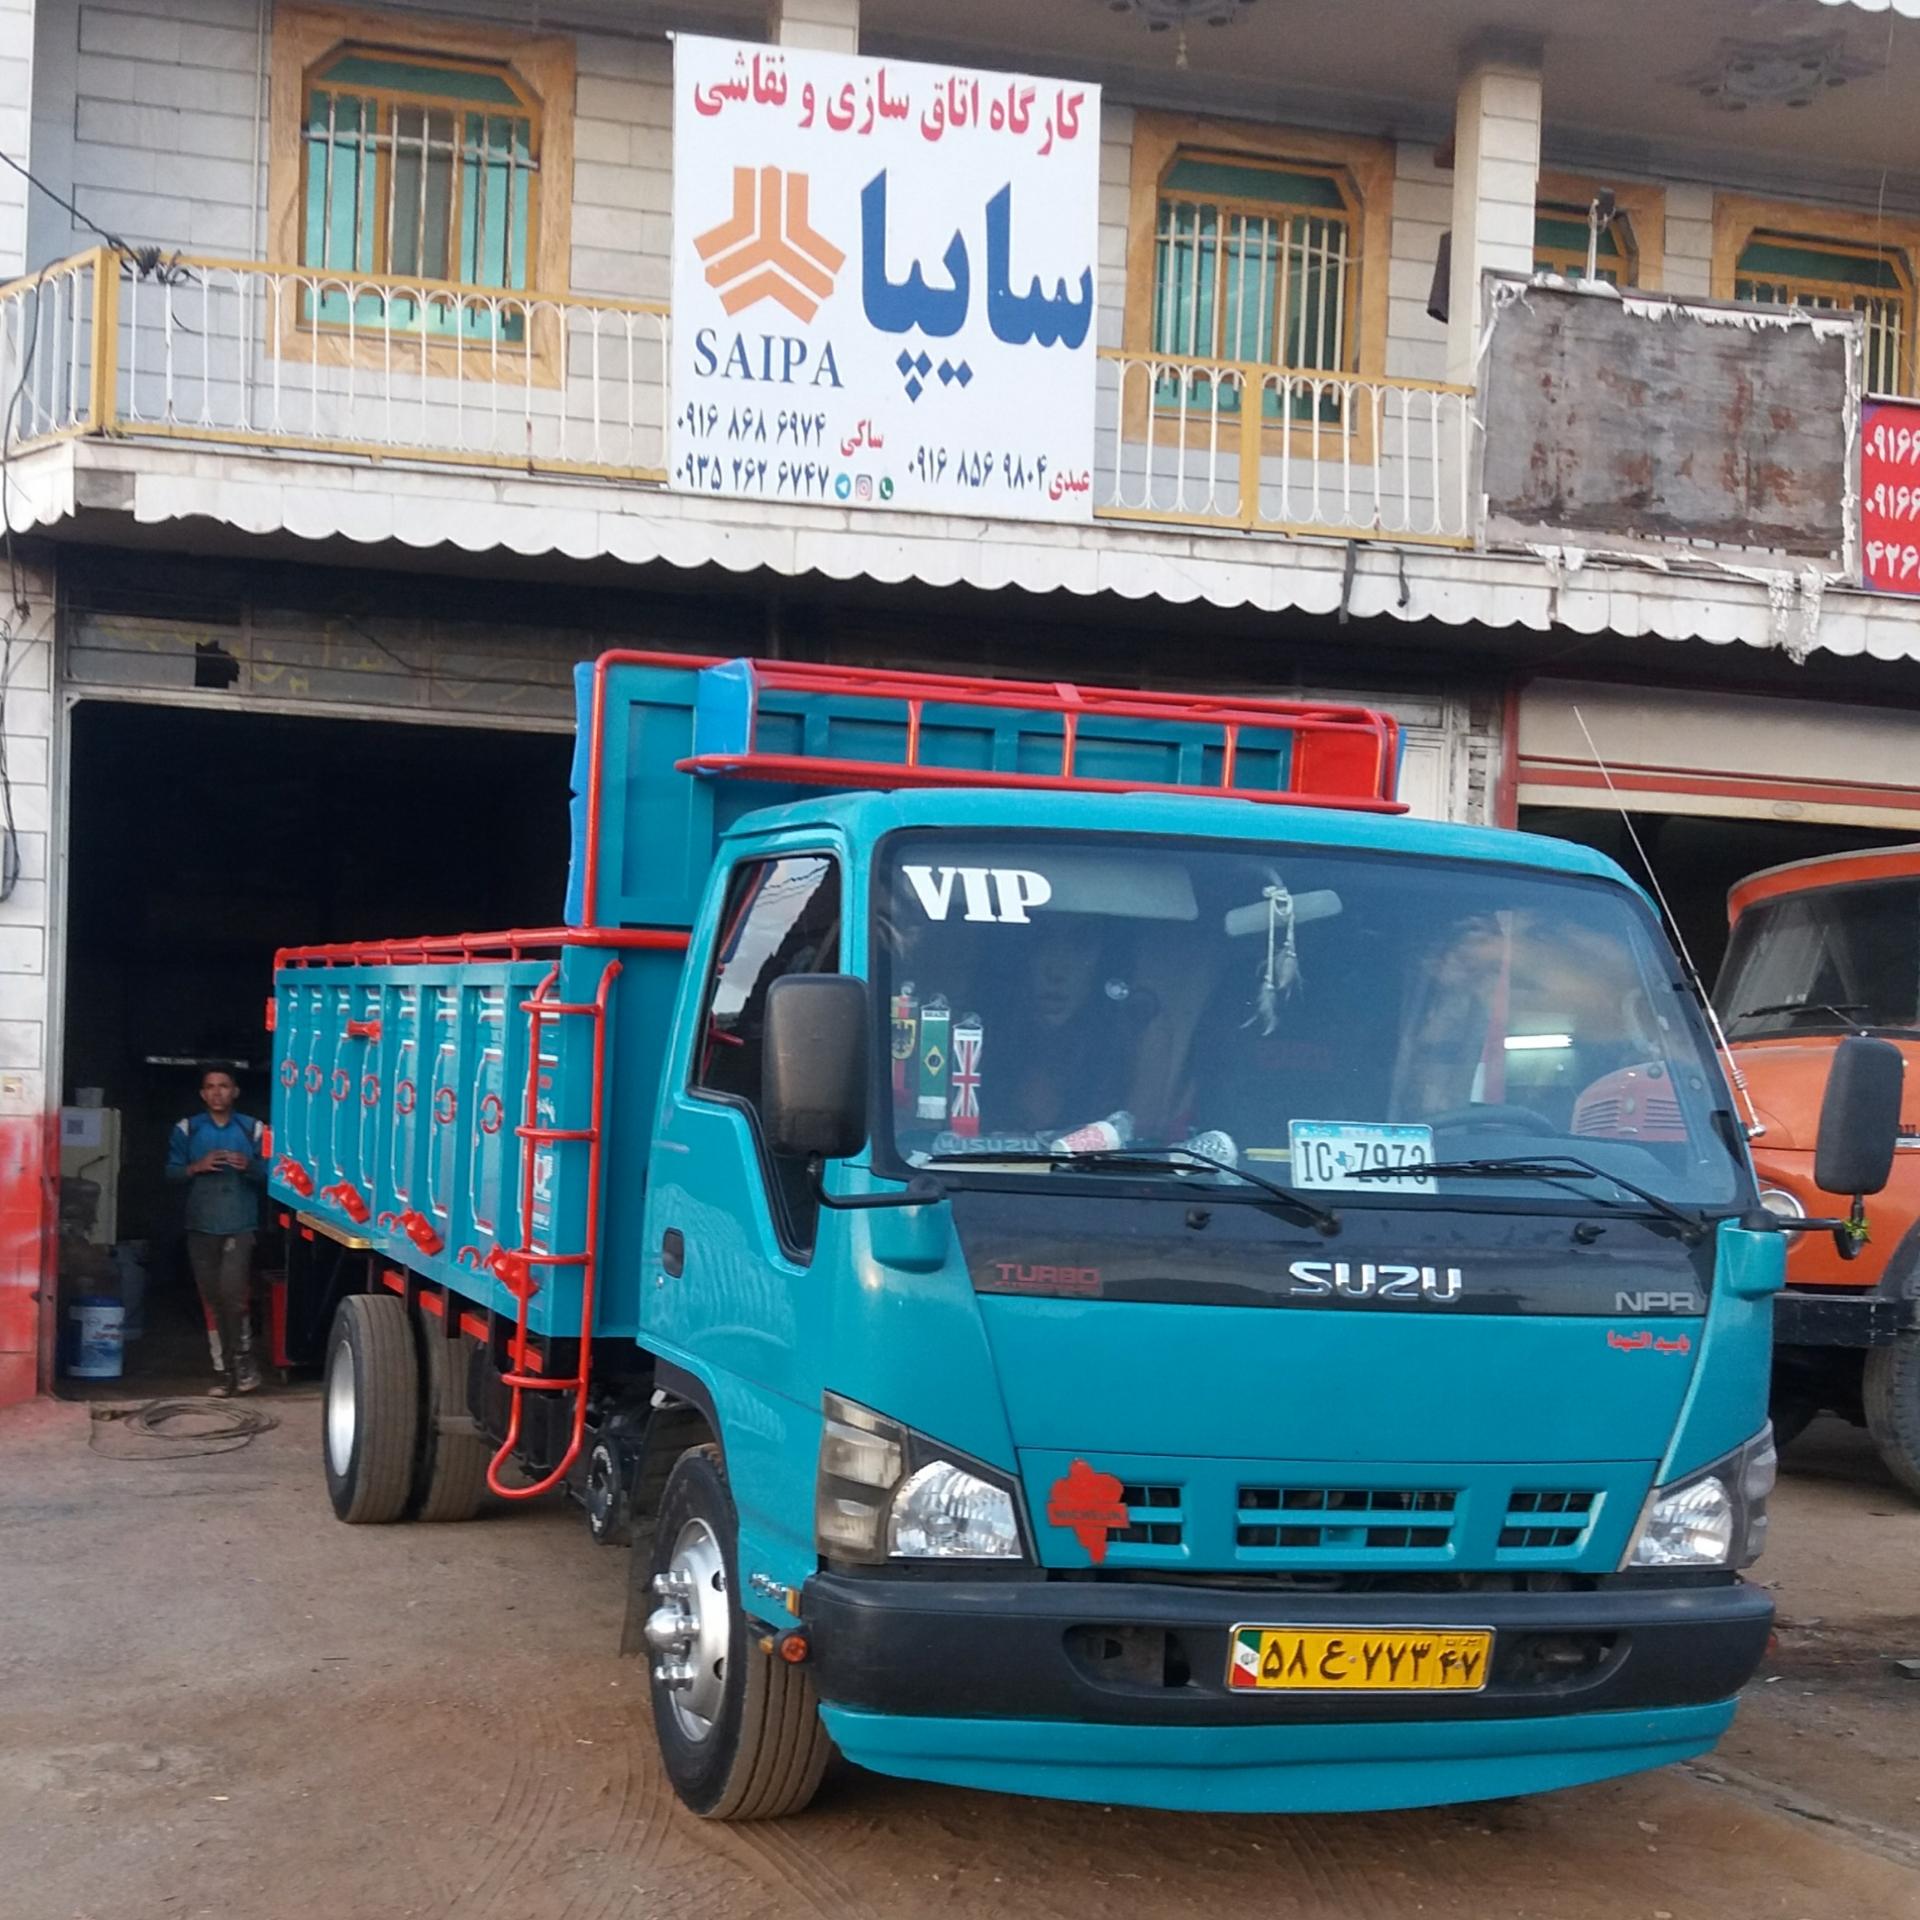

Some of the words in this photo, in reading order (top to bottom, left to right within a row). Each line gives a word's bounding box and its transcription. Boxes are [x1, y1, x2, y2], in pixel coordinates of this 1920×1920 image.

[694, 51, 789, 117] نقاشی
[826, 67, 910, 135] سازی
[798, 83, 816, 129] و
[919, 75, 980, 142] اتاق
[860, 168, 1094, 404] سایپا
[694, 327, 845, 389] SAIPA
[677, 401, 718, 438] ۰۹۱۶
[727, 405, 768, 443] ۸۶۸
[776, 409, 826, 447] ۶۹۷۴
[841, 419, 884, 457] ساکی
[676, 452, 723, 491] ۰۹۳۵
[776, 460, 830, 498] ۶۷۴۷
[908, 445, 948, 483] ۰۹۱۶
[957, 449, 994, 487] ۸۵۶
[1003, 452, 1048, 491] ۹۸۰۴
[1048, 470, 1091, 501] عبدی
[1866, 540, 1920, 579] ۴۲۶
[902, 865, 1052, 924] VIP
[995, 1263, 1100, 1285] TURBO
[1289, 1262, 1462, 1303] SUZU
[1615, 1291, 1695, 1312] NPR
[1262, 1639, 1308, 1680] ۵۸
[1319, 1640, 1347, 1681] ع
[1362, 1641, 1432, 1683] ۷۷۳
[1438, 1649, 1481, 1684] ۴۷
